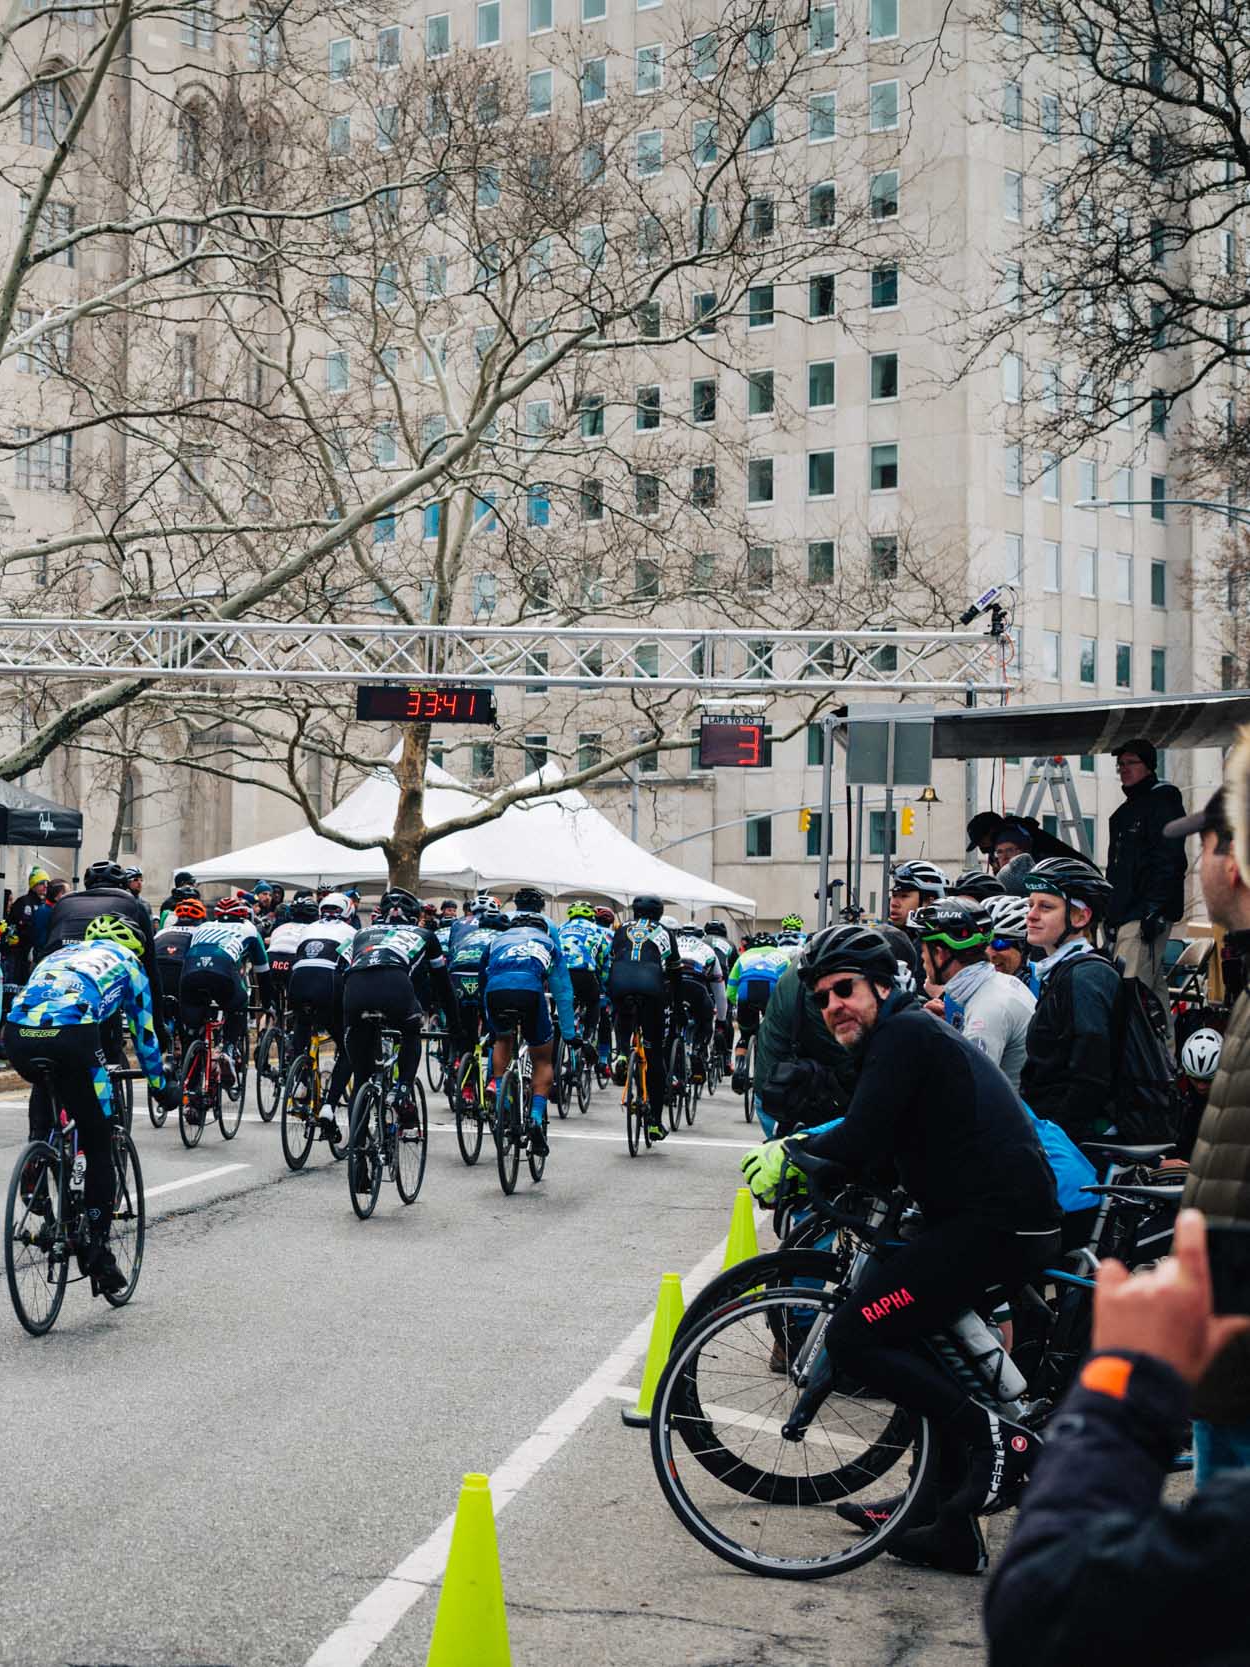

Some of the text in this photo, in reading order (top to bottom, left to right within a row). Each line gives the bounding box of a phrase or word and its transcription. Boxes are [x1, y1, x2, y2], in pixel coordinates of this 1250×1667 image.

[407, 692, 475, 716] 33:41
[709, 716, 728, 724] LAPS
[731, 717, 740, 725] TO
[737, 726, 759, 765] 3
[272, 960, 290, 970] RCC
[861, 1287, 916, 1324] RAPHA
